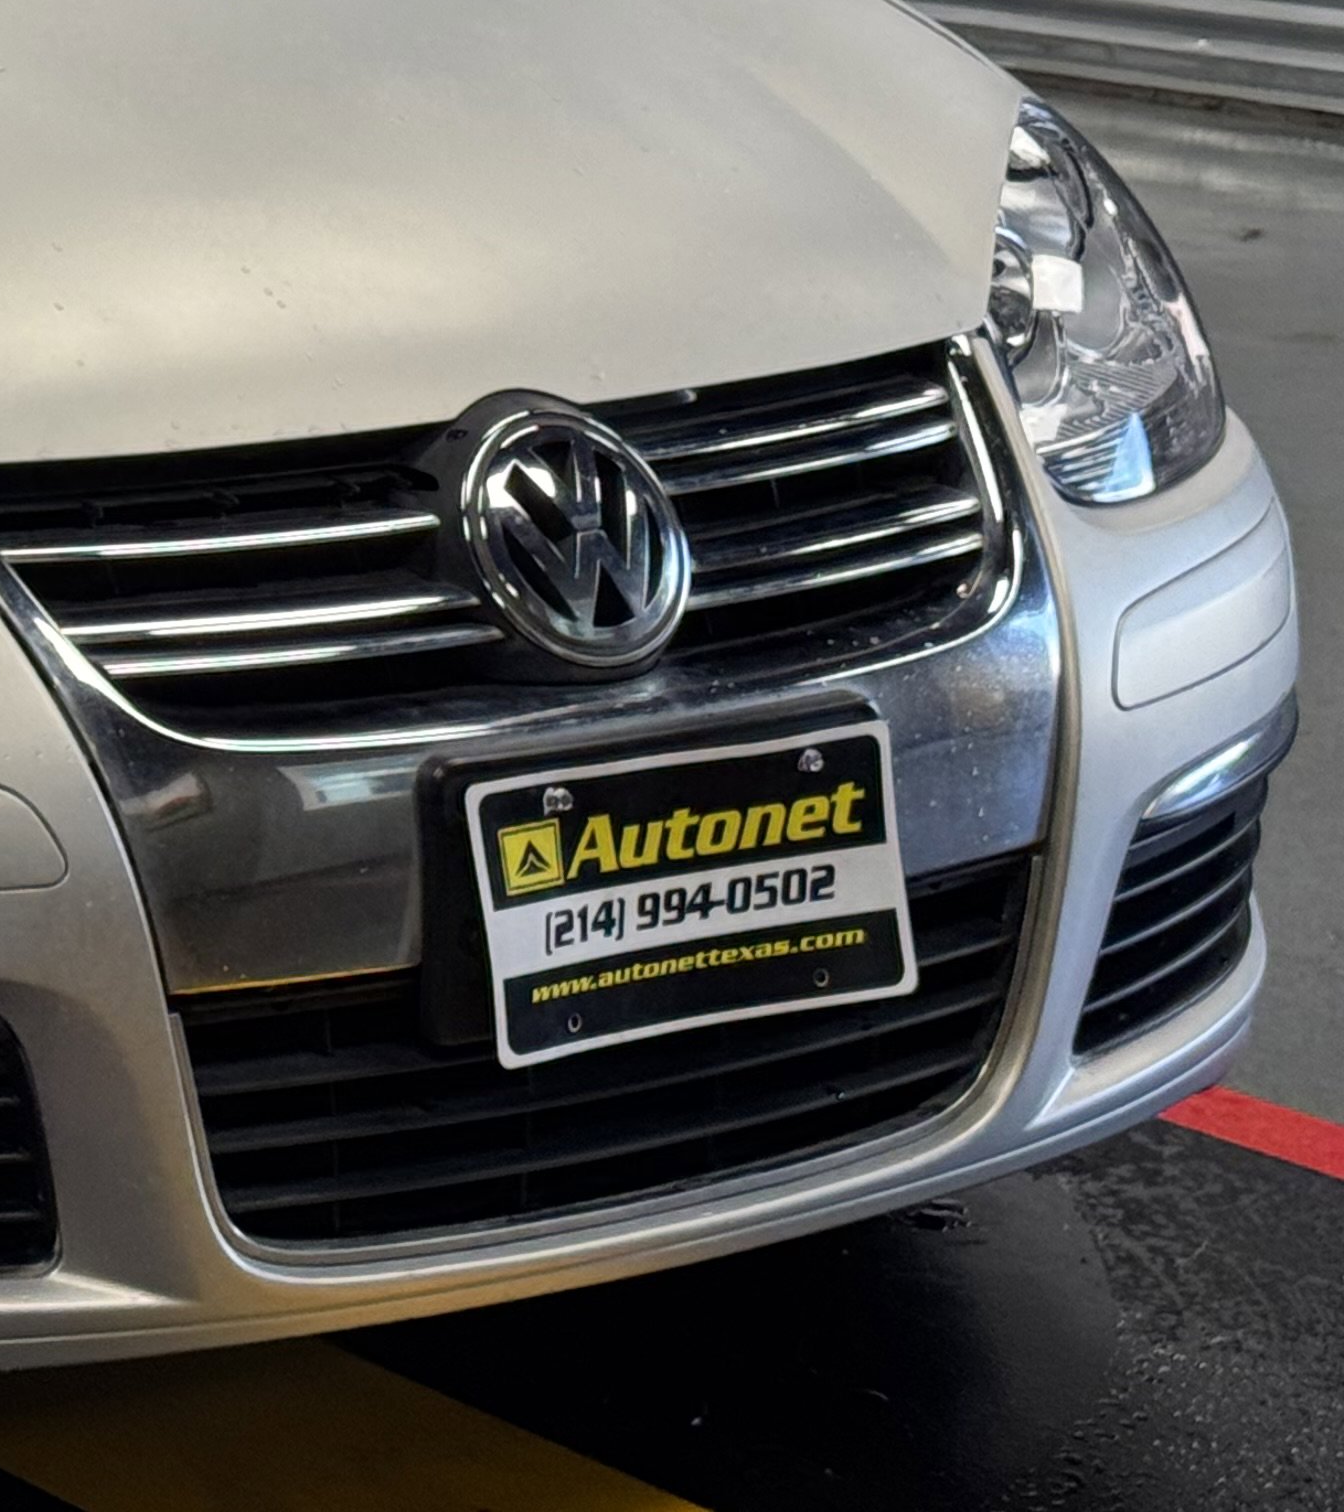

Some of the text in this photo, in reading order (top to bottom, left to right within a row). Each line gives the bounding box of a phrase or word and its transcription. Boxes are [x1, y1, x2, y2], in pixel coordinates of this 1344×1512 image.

[567, 782, 865, 881] Autonet
[545, 864, 836, 956] (214) 994-0502
[531, 926, 866, 1004] www.autonettexas.com
